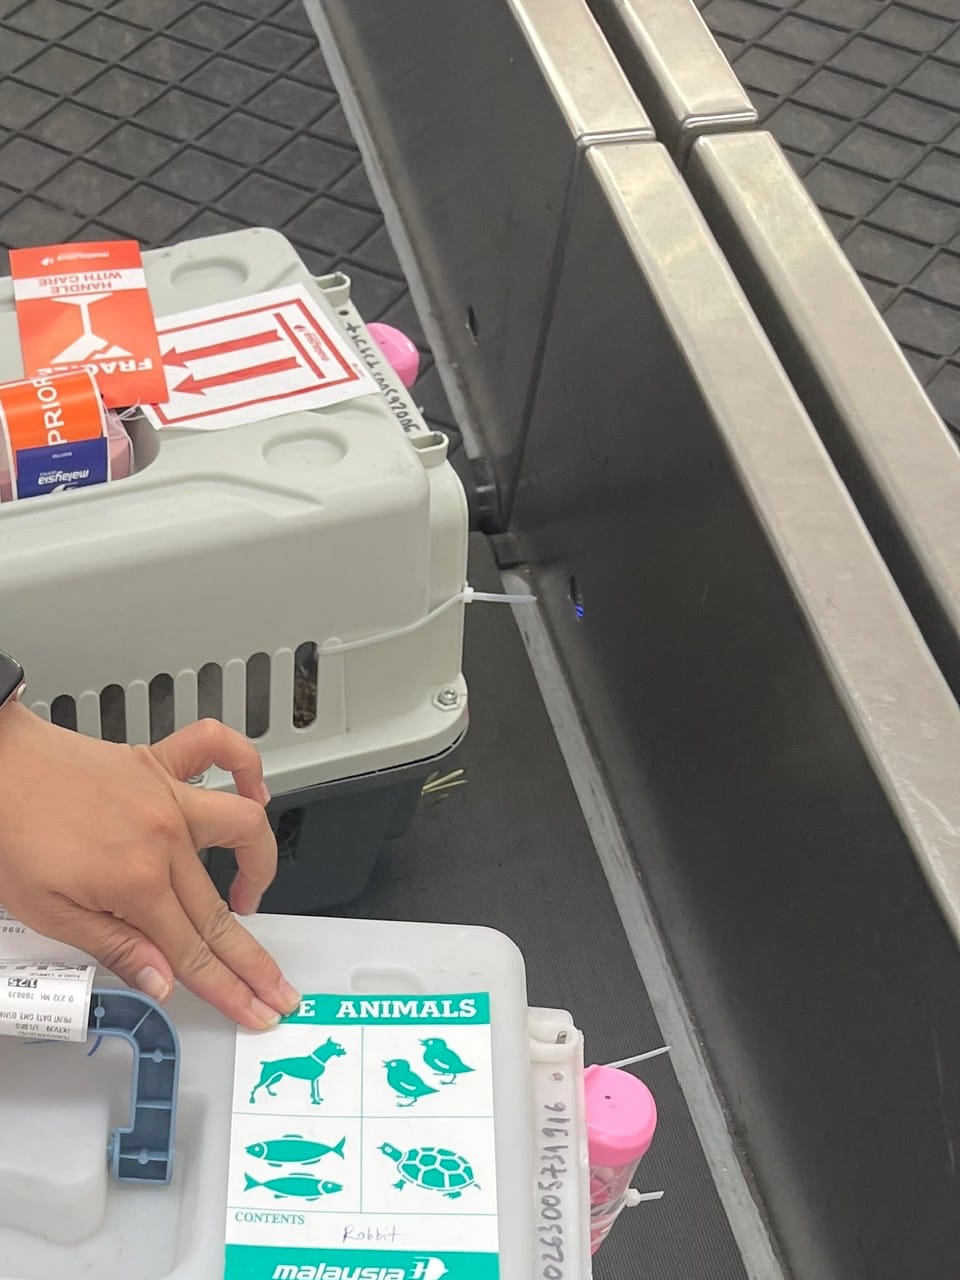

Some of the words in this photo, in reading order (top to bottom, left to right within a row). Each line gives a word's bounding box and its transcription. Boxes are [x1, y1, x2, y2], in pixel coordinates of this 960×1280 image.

[39, 274, 80, 287] CARE
[84, 271, 122, 281] WITH
[51, 281, 113, 294] HANDLE
[38, 470, 90, 485] malaysia
[8, 978, 38, 989] 125
[335, 998, 478, 1019] ANIMALS
[36, 1013, 52, 1023] DATE
[234, 1211, 306, 1225] CONTENTS
